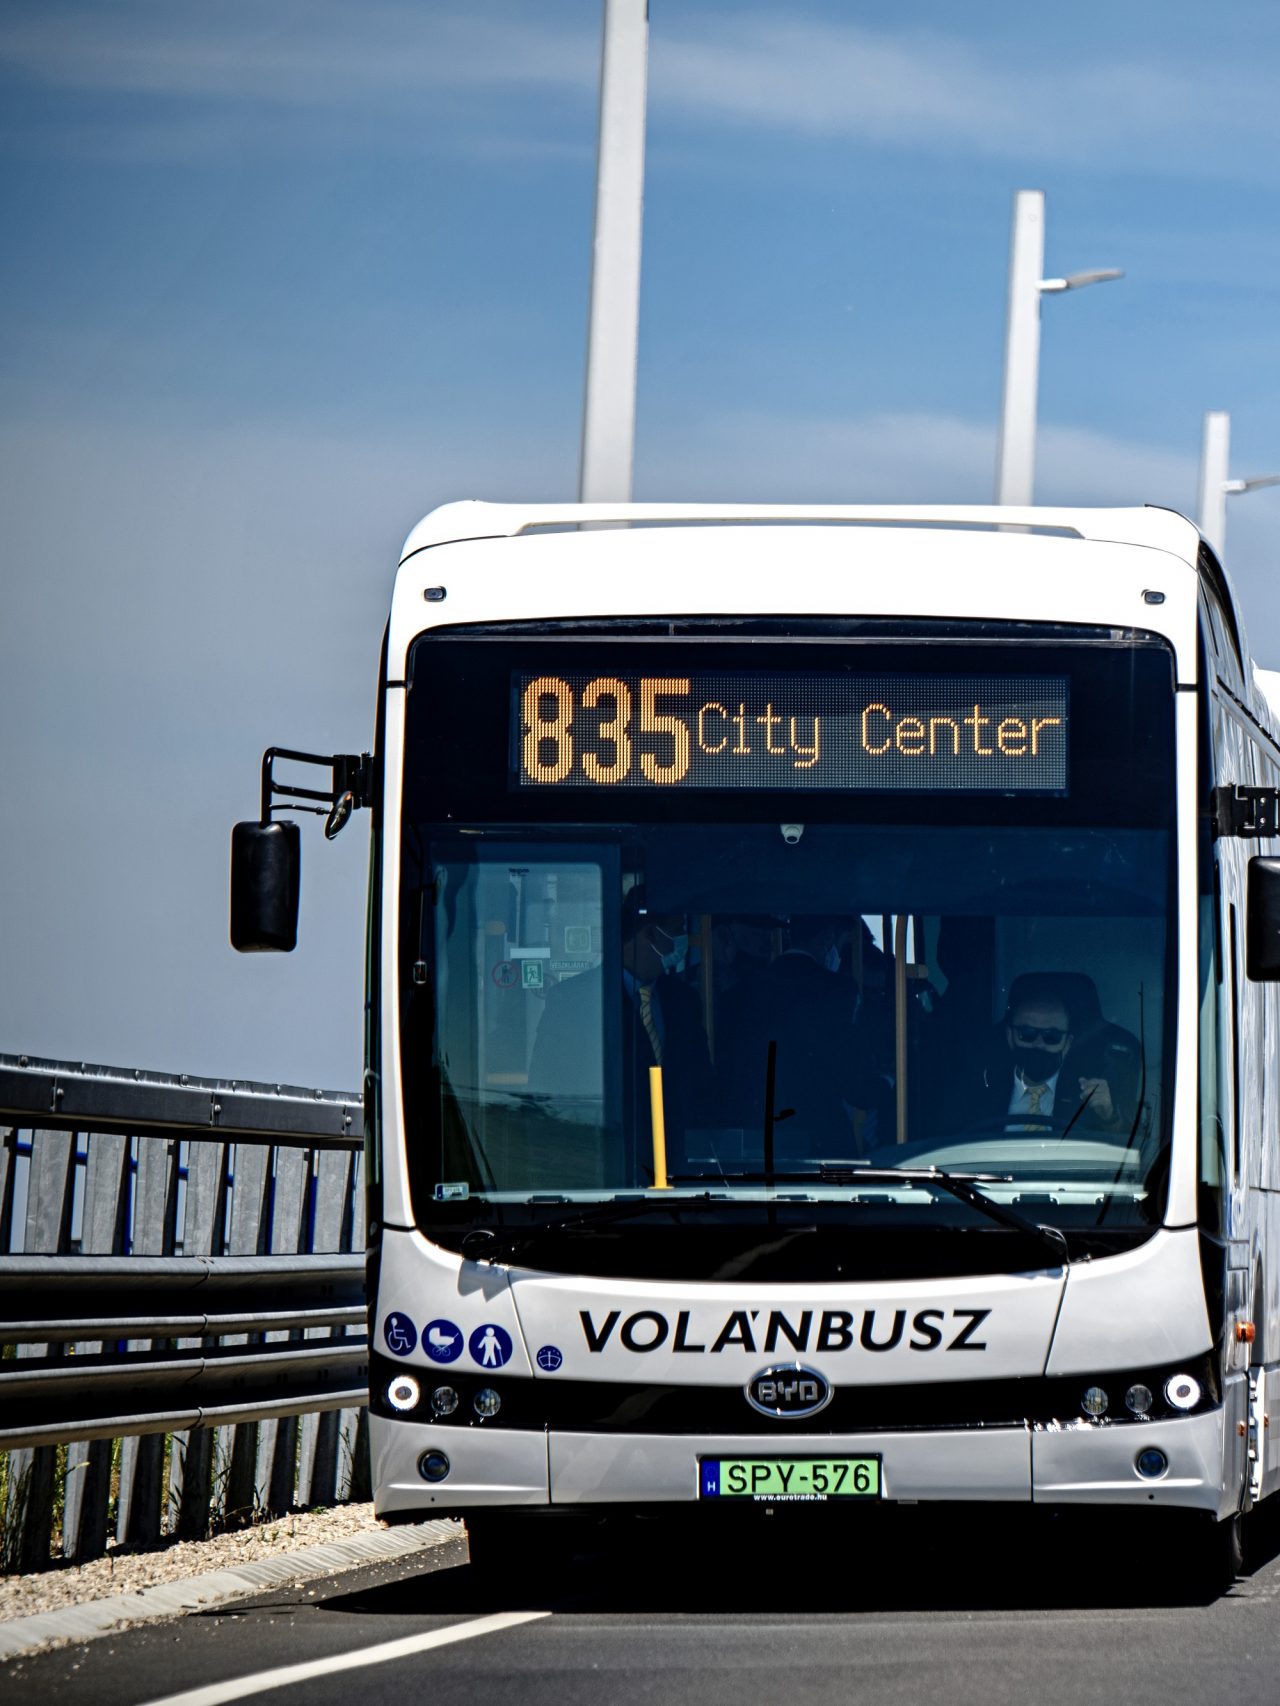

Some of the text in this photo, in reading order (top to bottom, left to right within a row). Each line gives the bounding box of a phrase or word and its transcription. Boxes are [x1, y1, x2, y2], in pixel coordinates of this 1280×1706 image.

[523, 676, 1060, 784] 835 City Center
[579, 1309, 992, 1353] VOLÁNBUSZ
[758, 1380, 819, 1401] BYD
[707, 1481, 716, 1492] H
[727, 1464, 871, 1492] SPY-576
